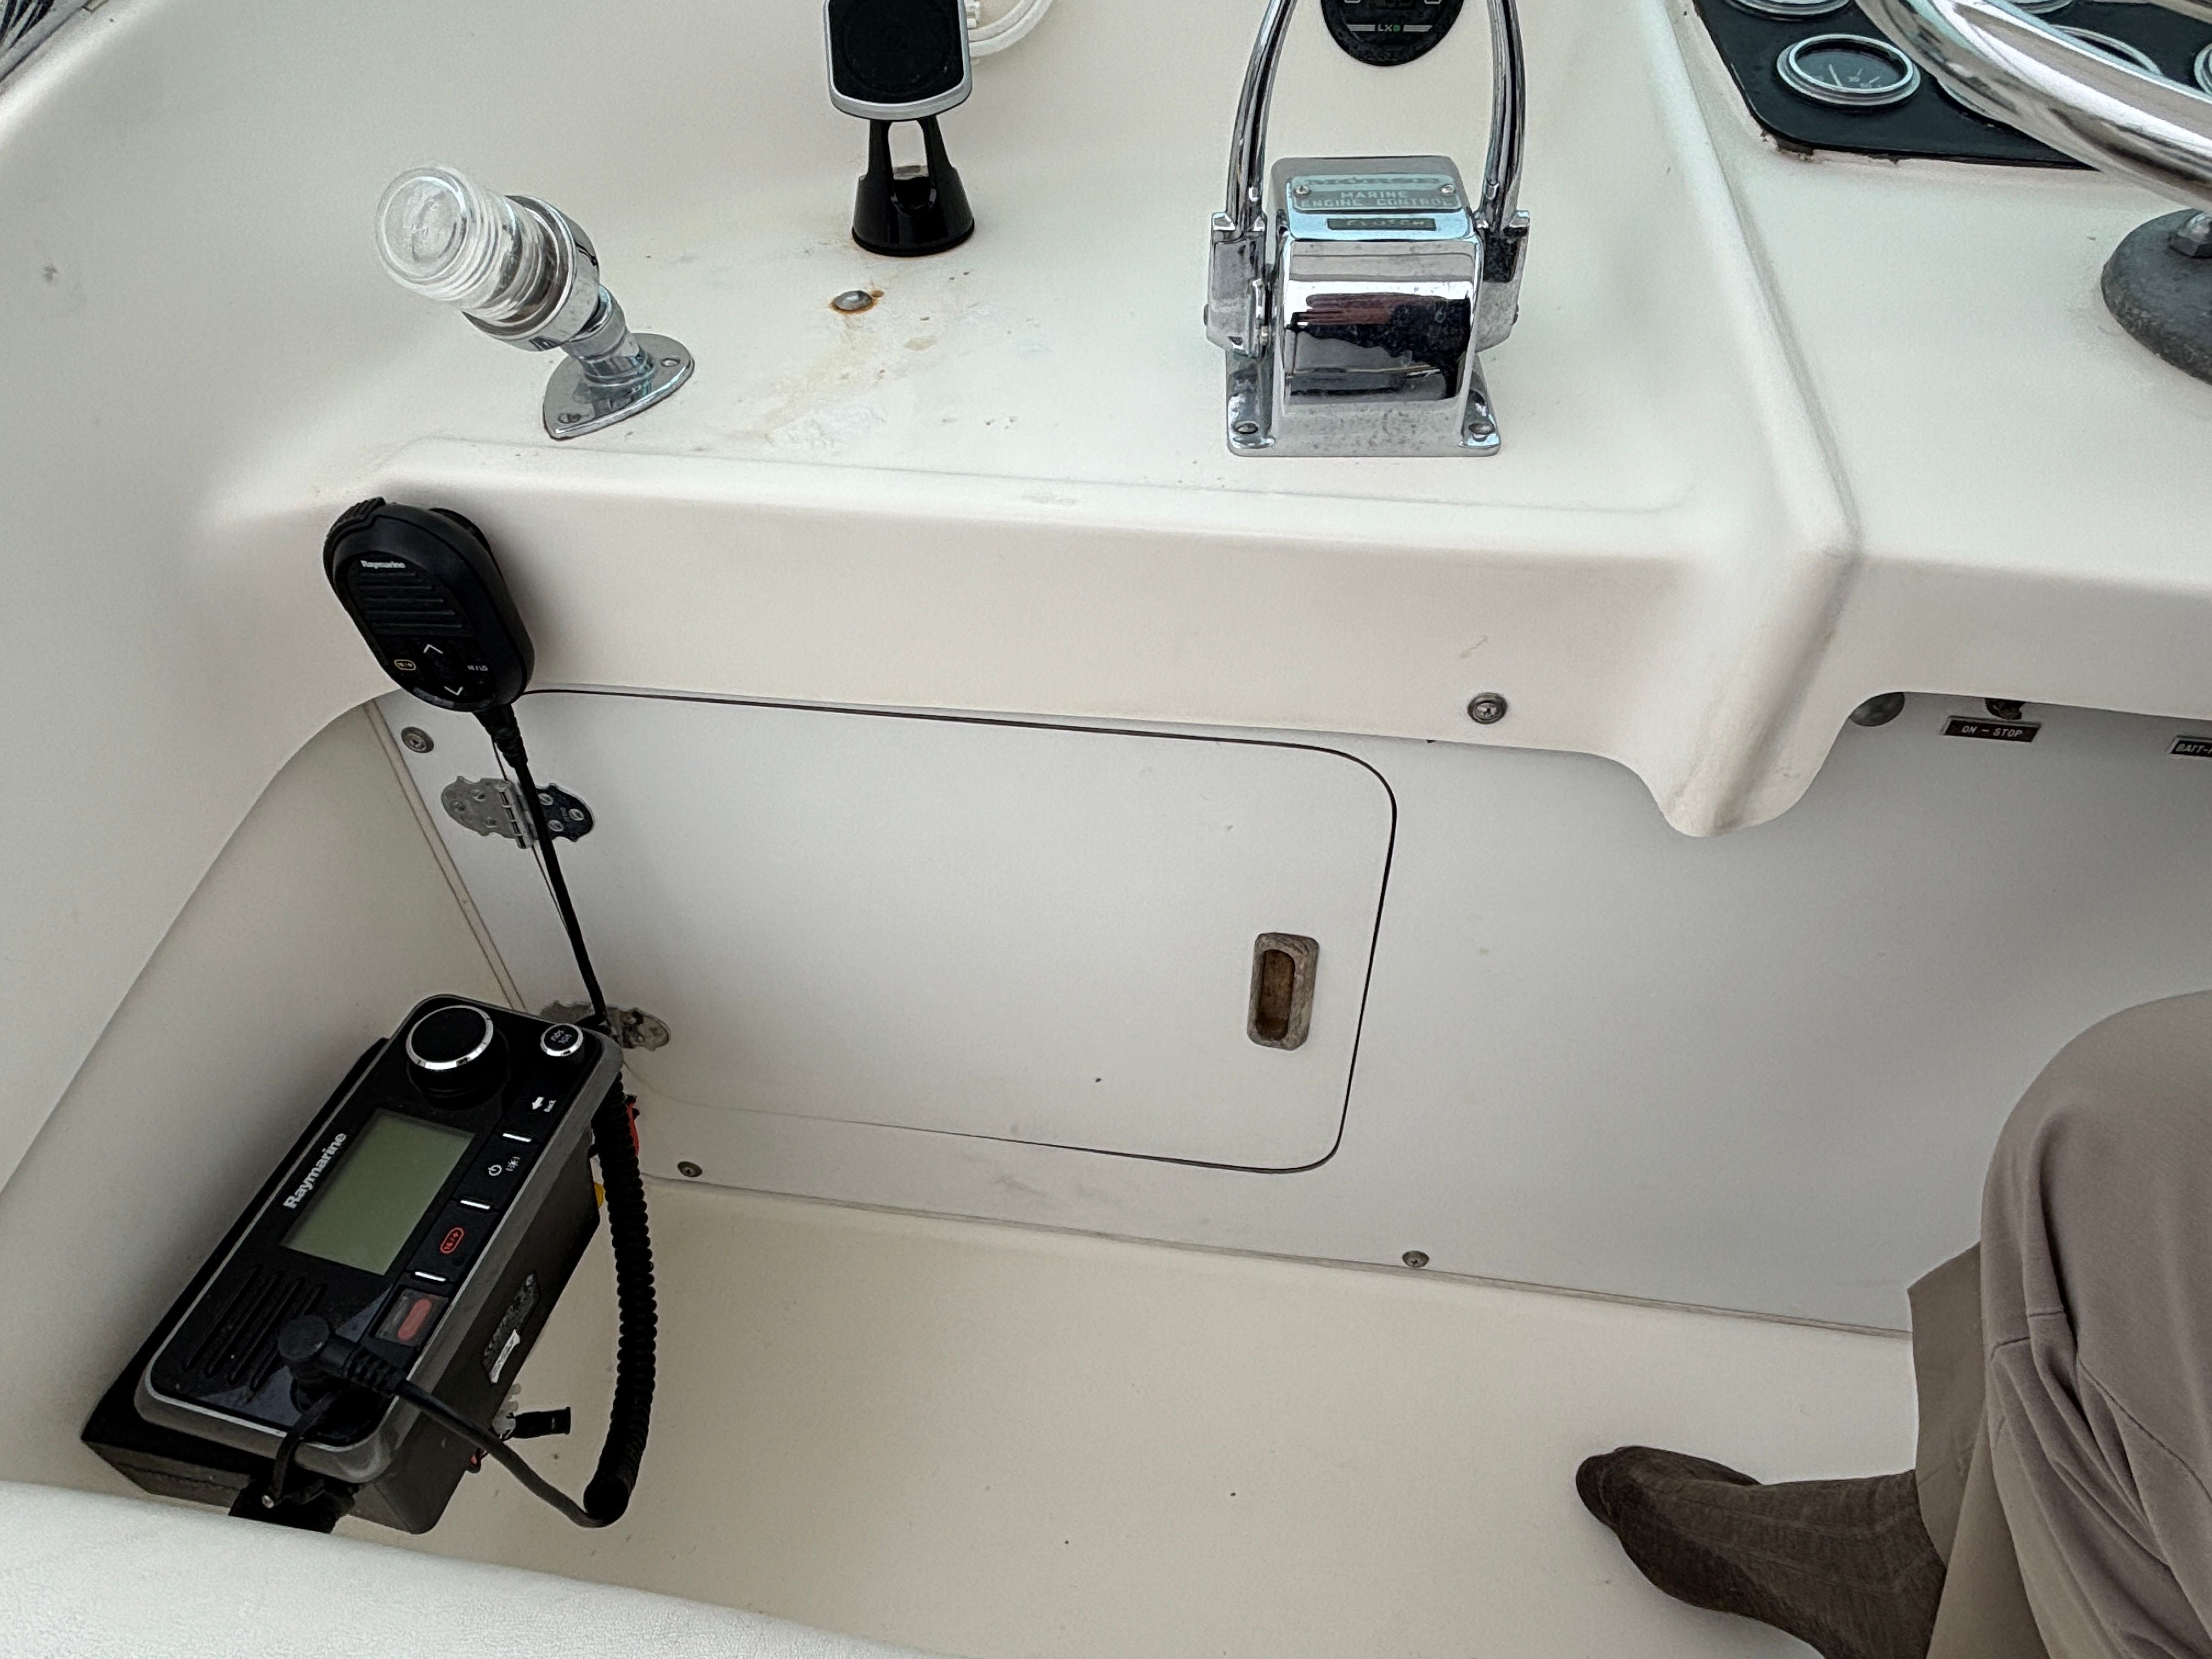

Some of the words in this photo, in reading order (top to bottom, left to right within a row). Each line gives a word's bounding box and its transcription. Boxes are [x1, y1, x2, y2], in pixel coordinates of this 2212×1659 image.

[1301, 199, 1363, 207] ENGINE
[1376, 198, 1455, 206] CONTROL
[1961, 725, 1978, 734] ON
[1993, 727, 2024, 737] STOP
[283, 1133, 347, 1209] Raymarine
